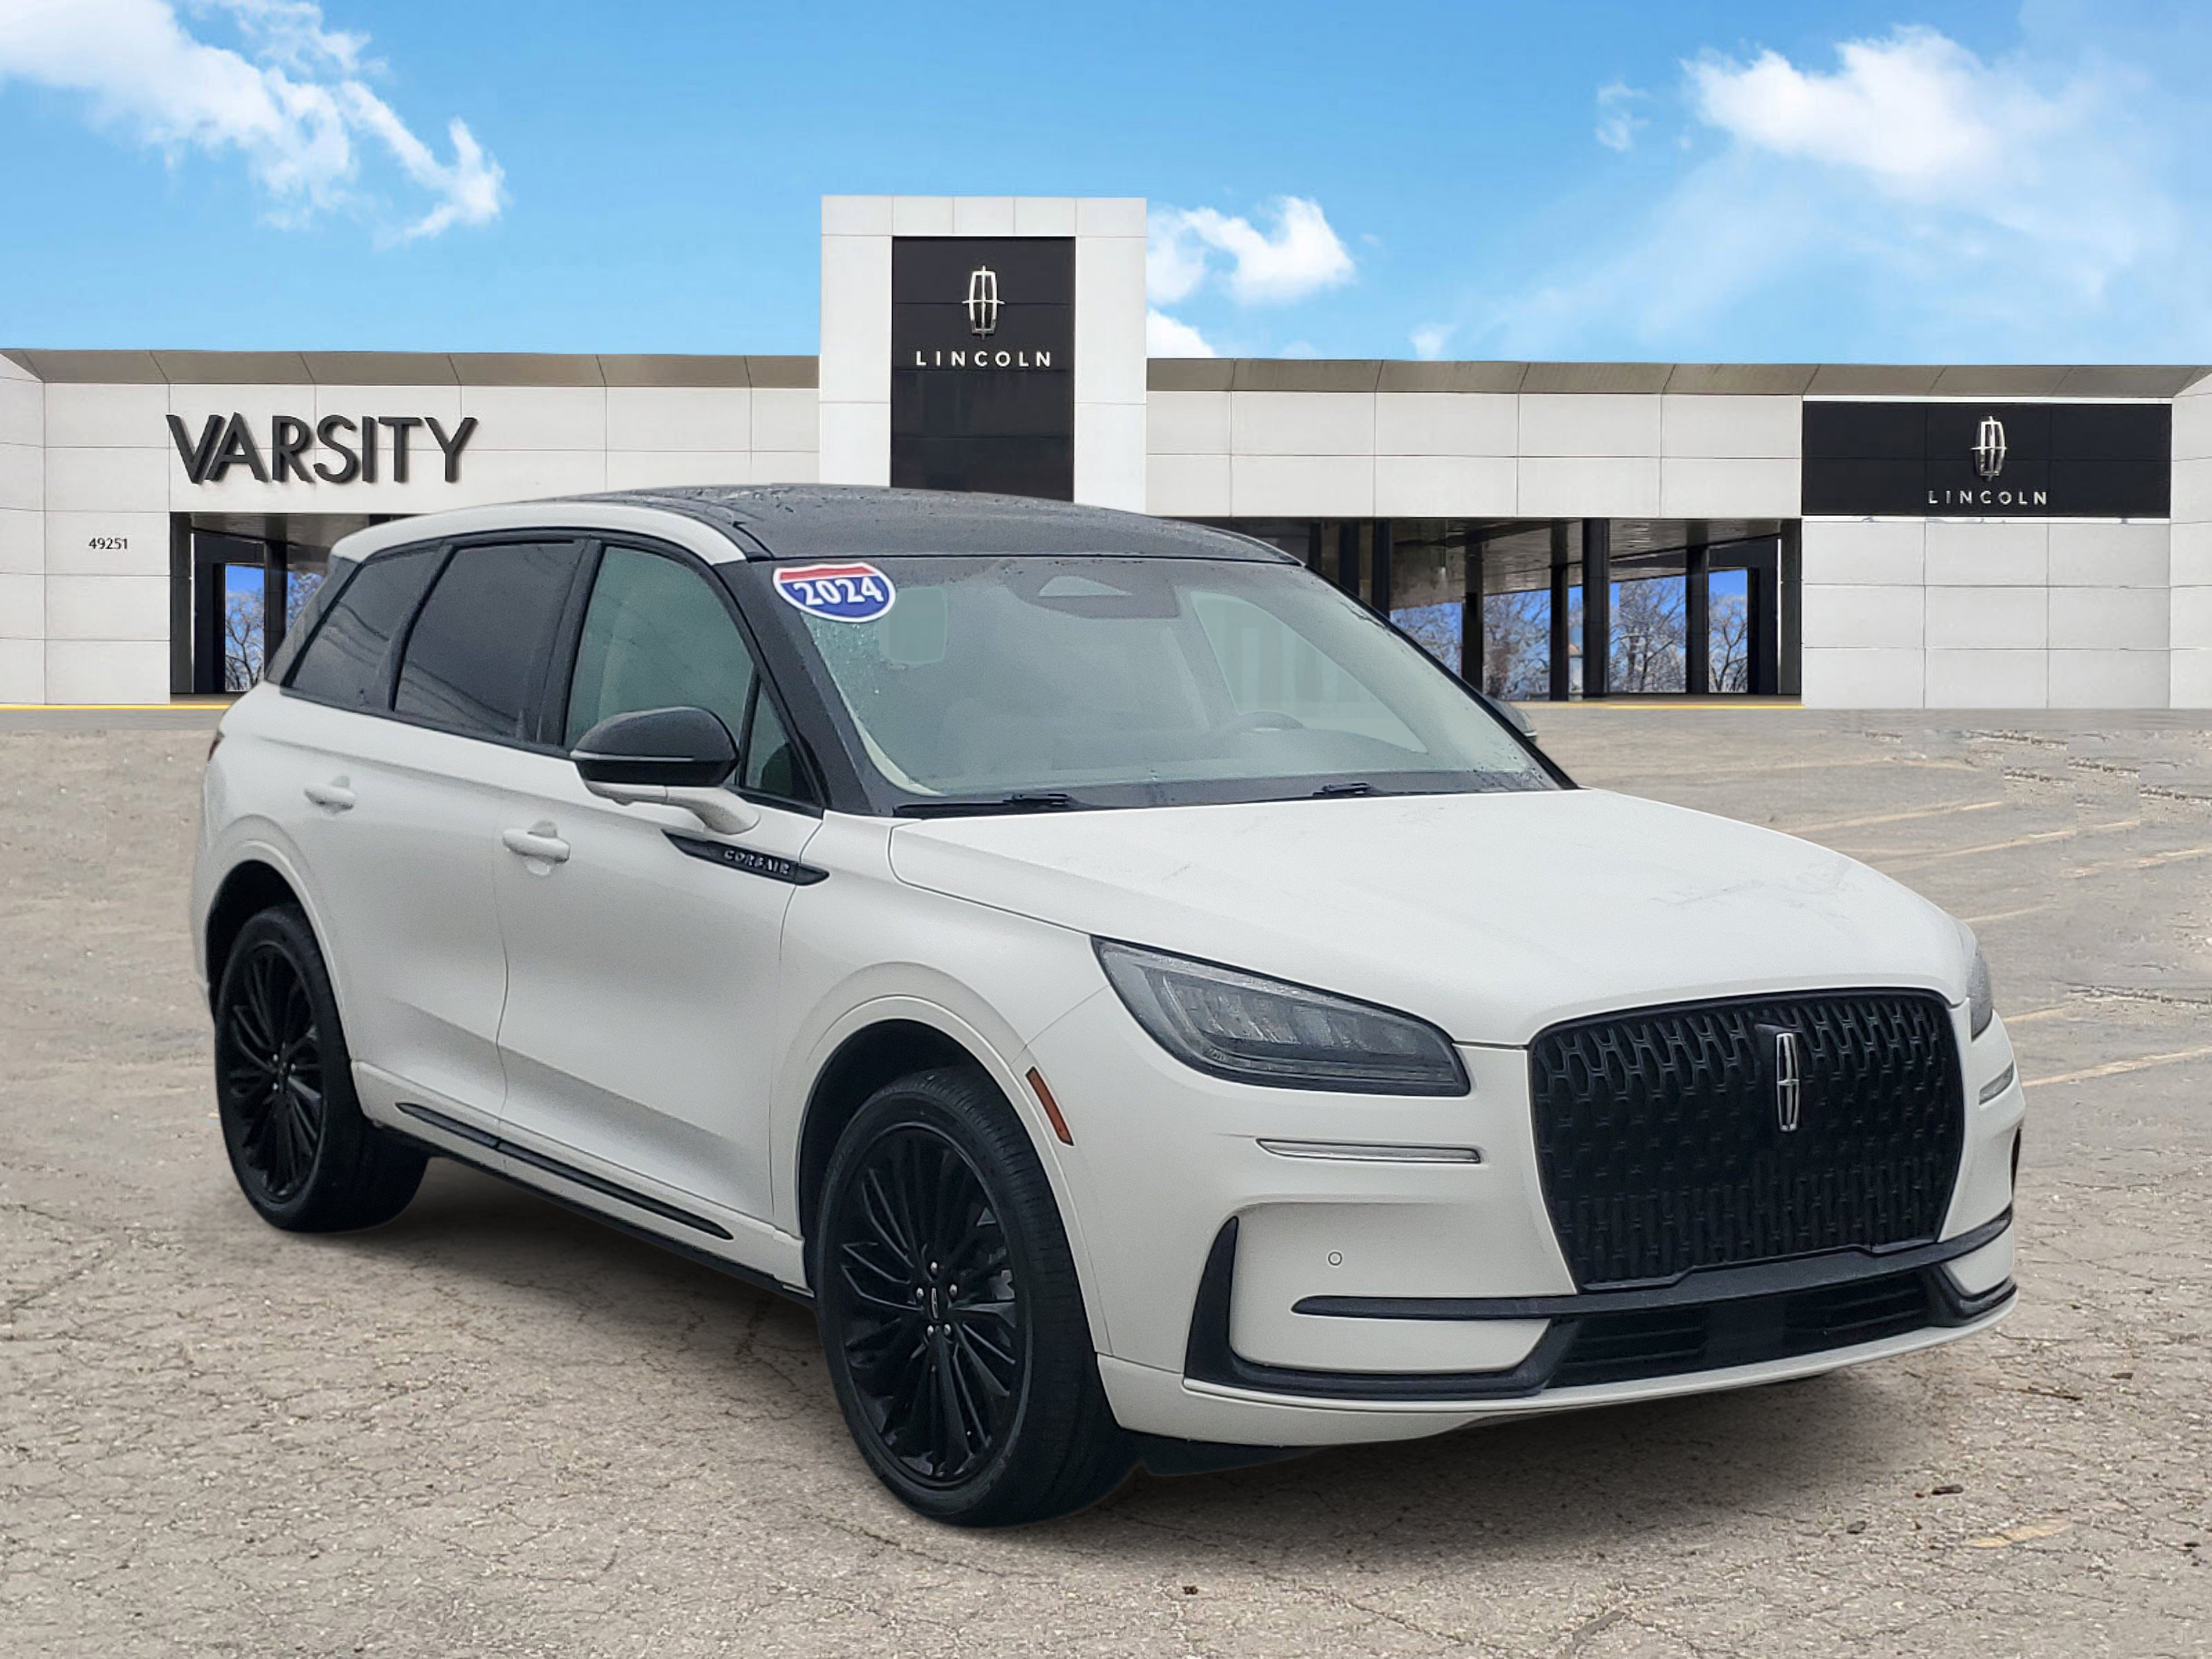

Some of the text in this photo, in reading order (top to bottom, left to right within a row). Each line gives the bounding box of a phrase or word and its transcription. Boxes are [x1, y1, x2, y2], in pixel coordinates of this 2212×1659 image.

[916, 350, 1050, 367] LINCOLN
[166, 412, 478, 484] VARSITY
[1929, 490, 2047, 504] LINCOLN
[89, 537, 127, 549] 49251
[793, 576, 884, 605] 2024
